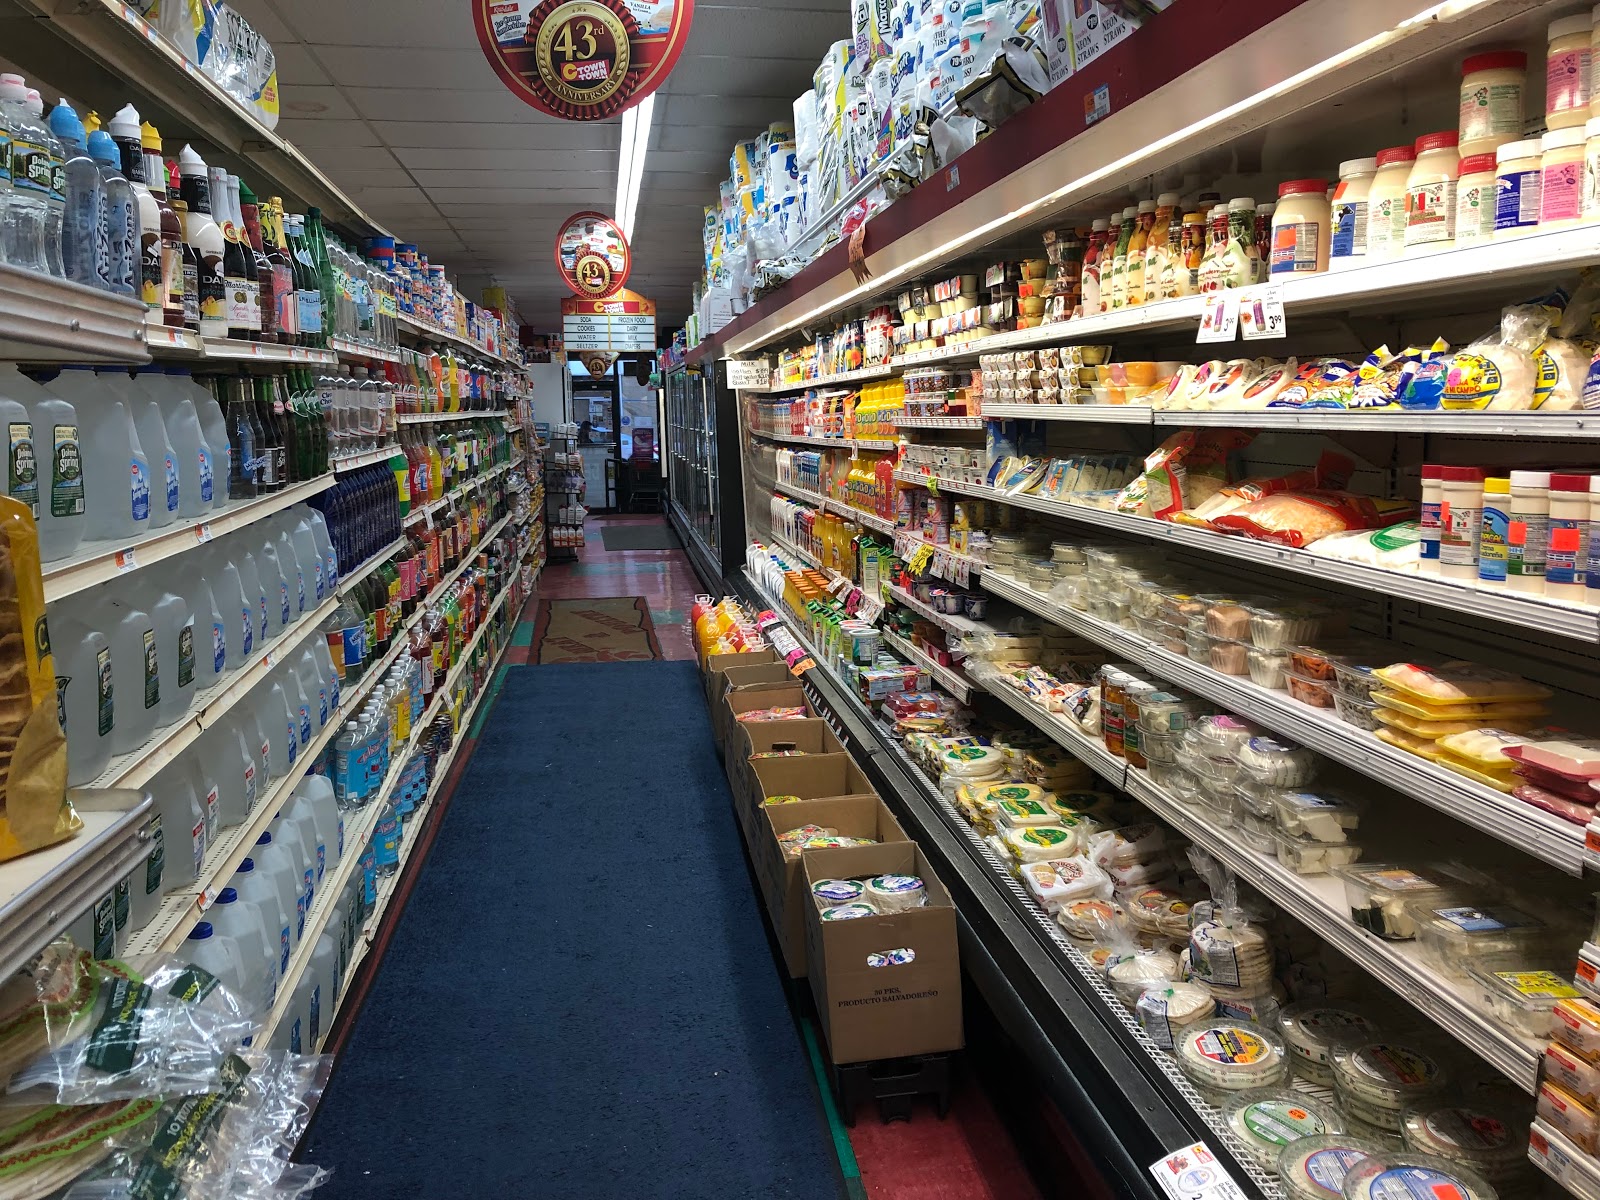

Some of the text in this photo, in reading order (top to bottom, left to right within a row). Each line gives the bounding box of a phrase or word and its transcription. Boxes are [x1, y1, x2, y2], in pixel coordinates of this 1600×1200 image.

[1102, 15, 1118, 32] NEON
[1103, 22, 1126, 45] STRAWS
[1076, 35, 1092, 51] NEON
[1077, 44, 1100, 64] STRAWS
[577, 61, 605, 73] TOWN
[1049, 57, 1062, 70] NEON
[579, 68, 608, 80] TOWN
[1051, 65, 1069, 82] STRAWS
[555, 80, 616, 100] ANNIVERSARY
[29, 165, 50, 178] Sprin
[583, 263, 599, 278] 43
[61, 448, 77, 458] Poland
[59, 458, 79, 473] Spring
[838, 990, 939, 1008] PRODUCTO SALVADOREÑO
